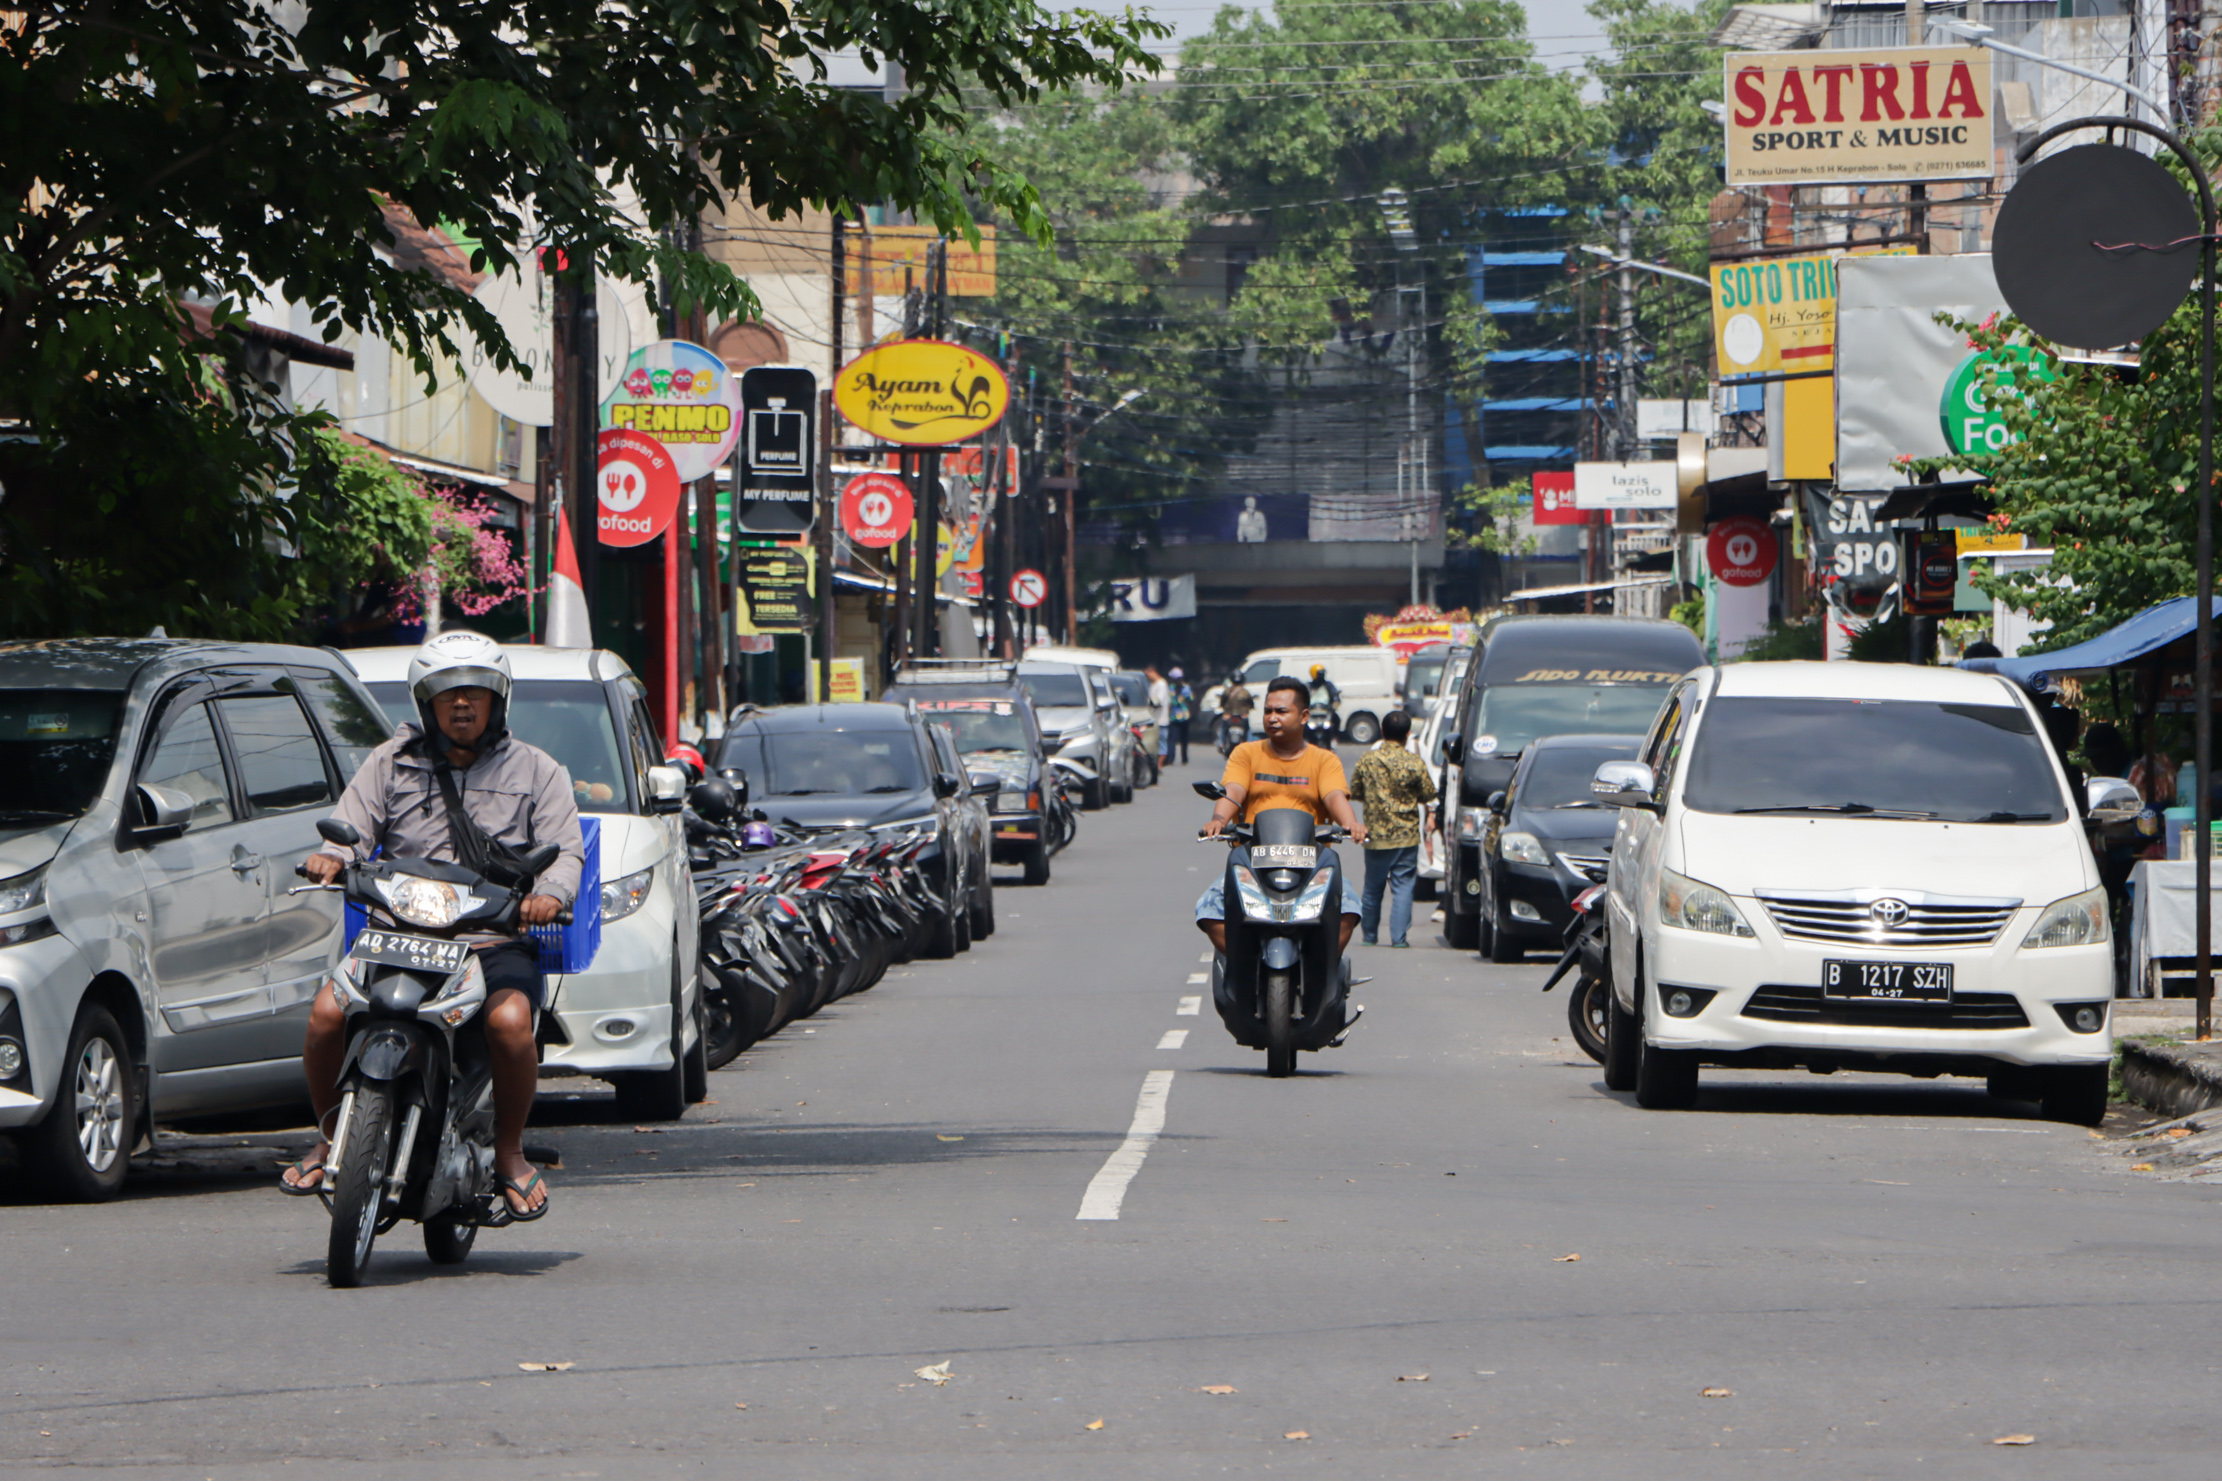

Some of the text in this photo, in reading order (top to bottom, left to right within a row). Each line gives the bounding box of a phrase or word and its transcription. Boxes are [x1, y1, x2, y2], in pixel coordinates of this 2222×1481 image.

[1734, 60, 1984, 128] SATRIA
[1752, 125, 1968, 151] SPORT & MUSIC
[1747, 168, 1773, 177] Teuku
[1775, 167, 1798, 175] Umar
[1827, 165, 1835, 173] H
[1837, 163, 1879, 174] Keprabon
[1887, 163, 1907, 172] Solo
[1720, 263, 1783, 309] SOTO
[1769, 309, 1833, 326] Hj. Yoso
[851, 372, 945, 402] Ayam
[867, 399, 956, 417] Keprabon
[612, 404, 731, 432] PENMO
[610, 437, 654, 459] dipesan
[652, 456, 666, 470] di
[760, 452, 797, 461] PERFUME
[1612, 475, 1649, 486] lazis
[743, 489, 810, 502] MY PERFUME
[1626, 485, 1662, 497] solo
[598, 514, 652, 533] ofood
[1828, 500, 1899, 534] SAT
[855, 527, 897, 541] gofood
[1722, 567, 1762, 580] gofood
[755, 604, 798, 614] TERSEDIA
[1253, 846, 1316, 858] AB 6446 DN
[358, 932, 384, 948] AD
[387, 936, 432, 953] 2764
[1829, 963, 1948, 989] B 1217 SZH
